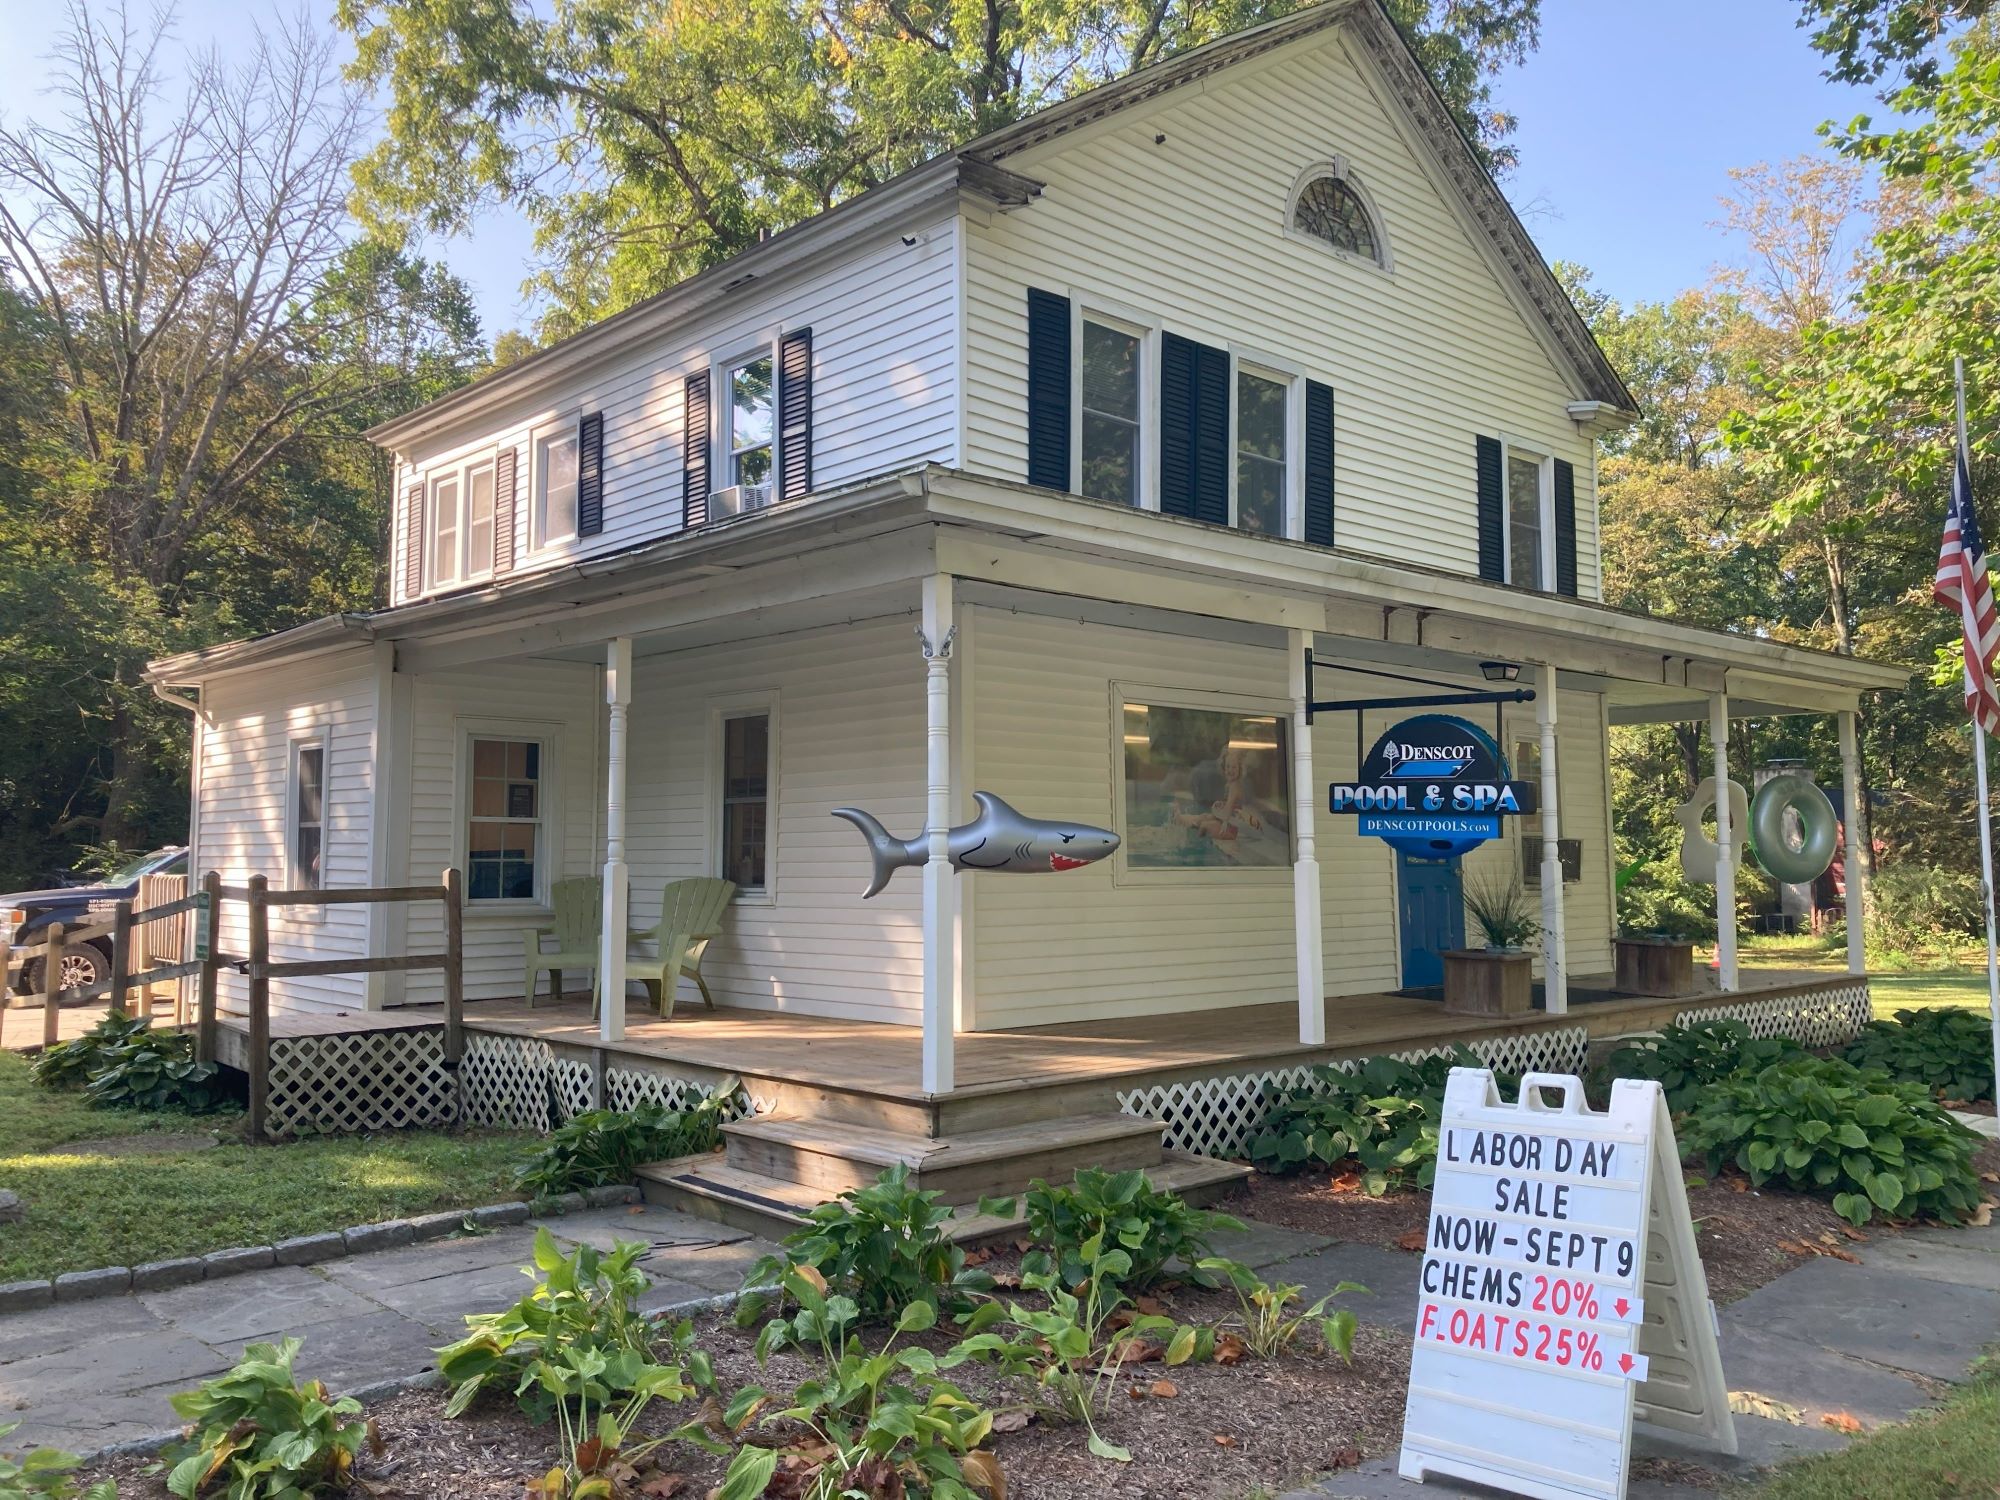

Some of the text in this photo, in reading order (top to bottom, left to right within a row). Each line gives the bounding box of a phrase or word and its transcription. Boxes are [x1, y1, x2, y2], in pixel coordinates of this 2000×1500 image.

[1400, 743, 1474, 760] DENSCOT
[1333, 784, 1520, 812] POOL & SPA
[1367, 819, 1490, 832] DENSCOTPOOLS.COM
[1447, 1130, 1615, 1178] LABOR DAY
[1495, 1177, 1570, 1220] SALE
[1422, 1259, 1599, 1320] CHEMS 20%
[1420, 1304, 1530, 1357] FOATS
